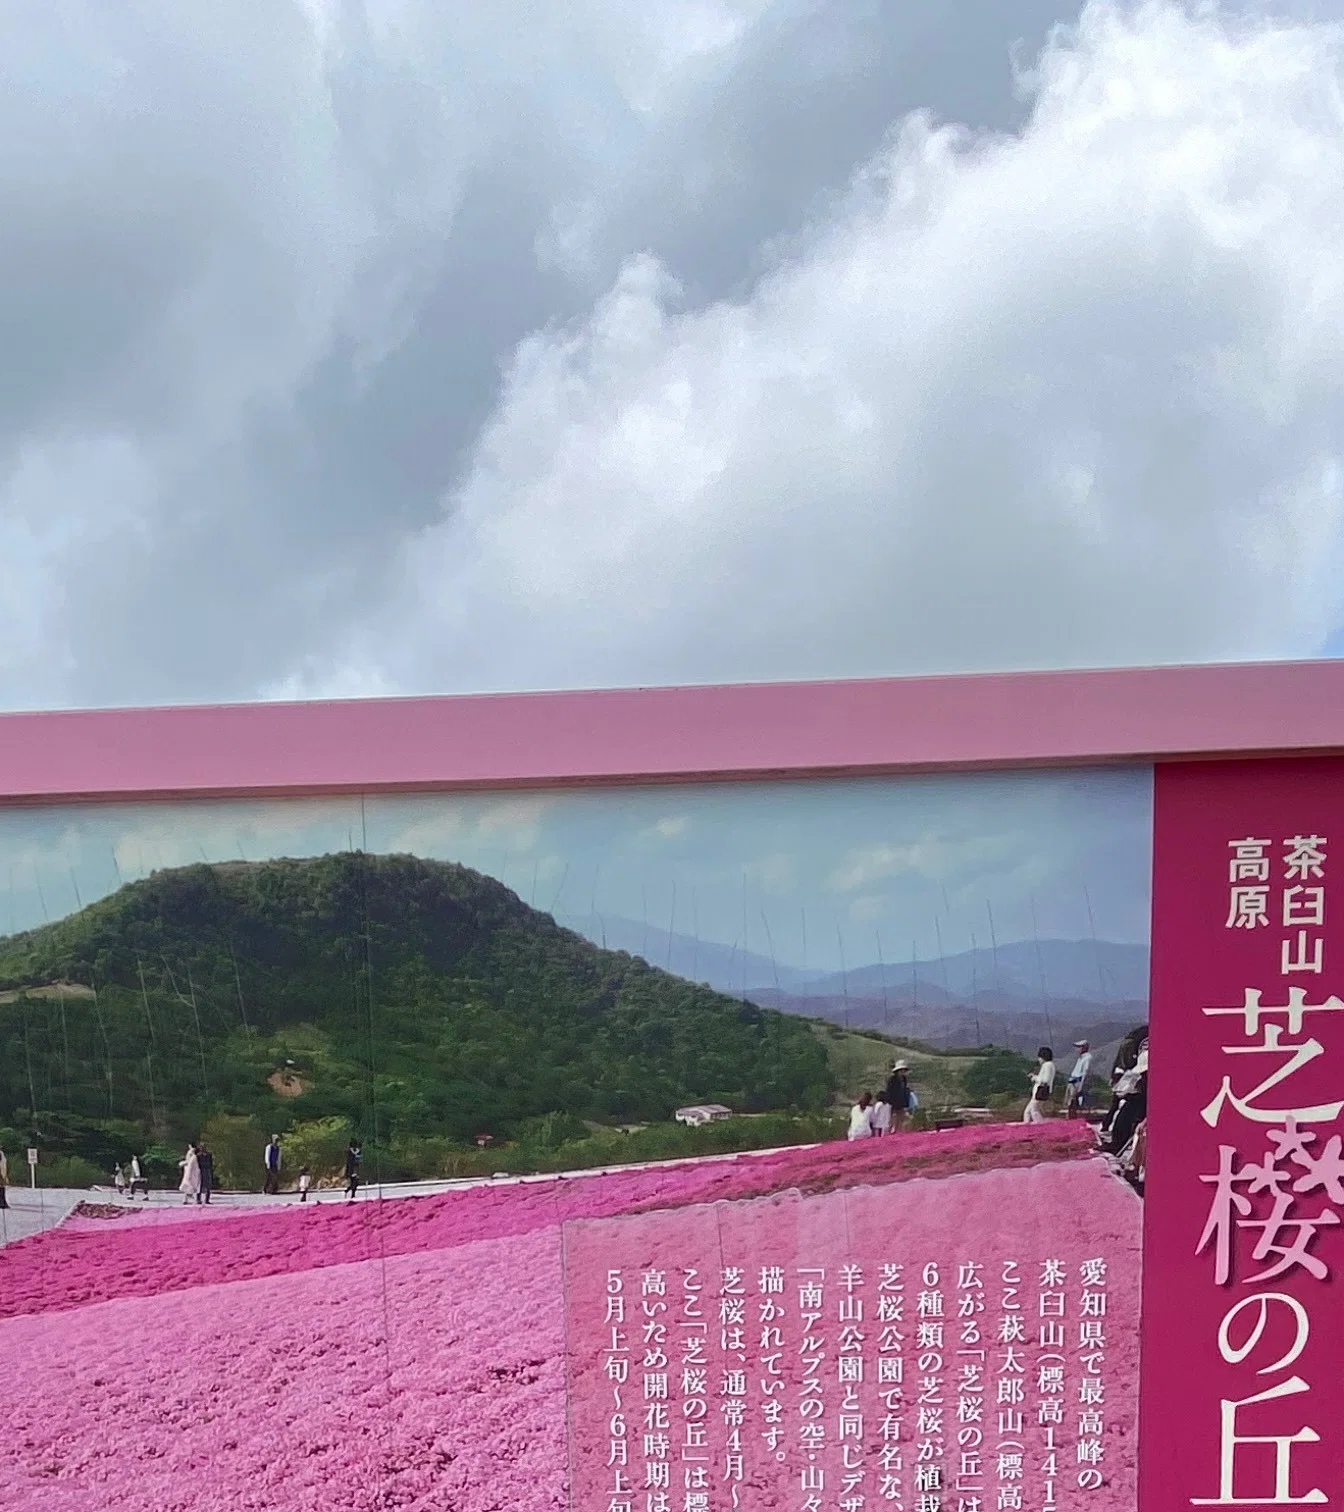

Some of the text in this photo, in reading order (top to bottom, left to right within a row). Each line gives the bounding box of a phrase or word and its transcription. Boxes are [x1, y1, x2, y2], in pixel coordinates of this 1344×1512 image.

[1225, 836, 1272, 930] 高原
[1281, 834, 1328, 975] 茶臼山
[758, 1267, 786, 1465] 描かれています。
[1076, 1257, 1108, 1490] 愛知県で最高峰の
